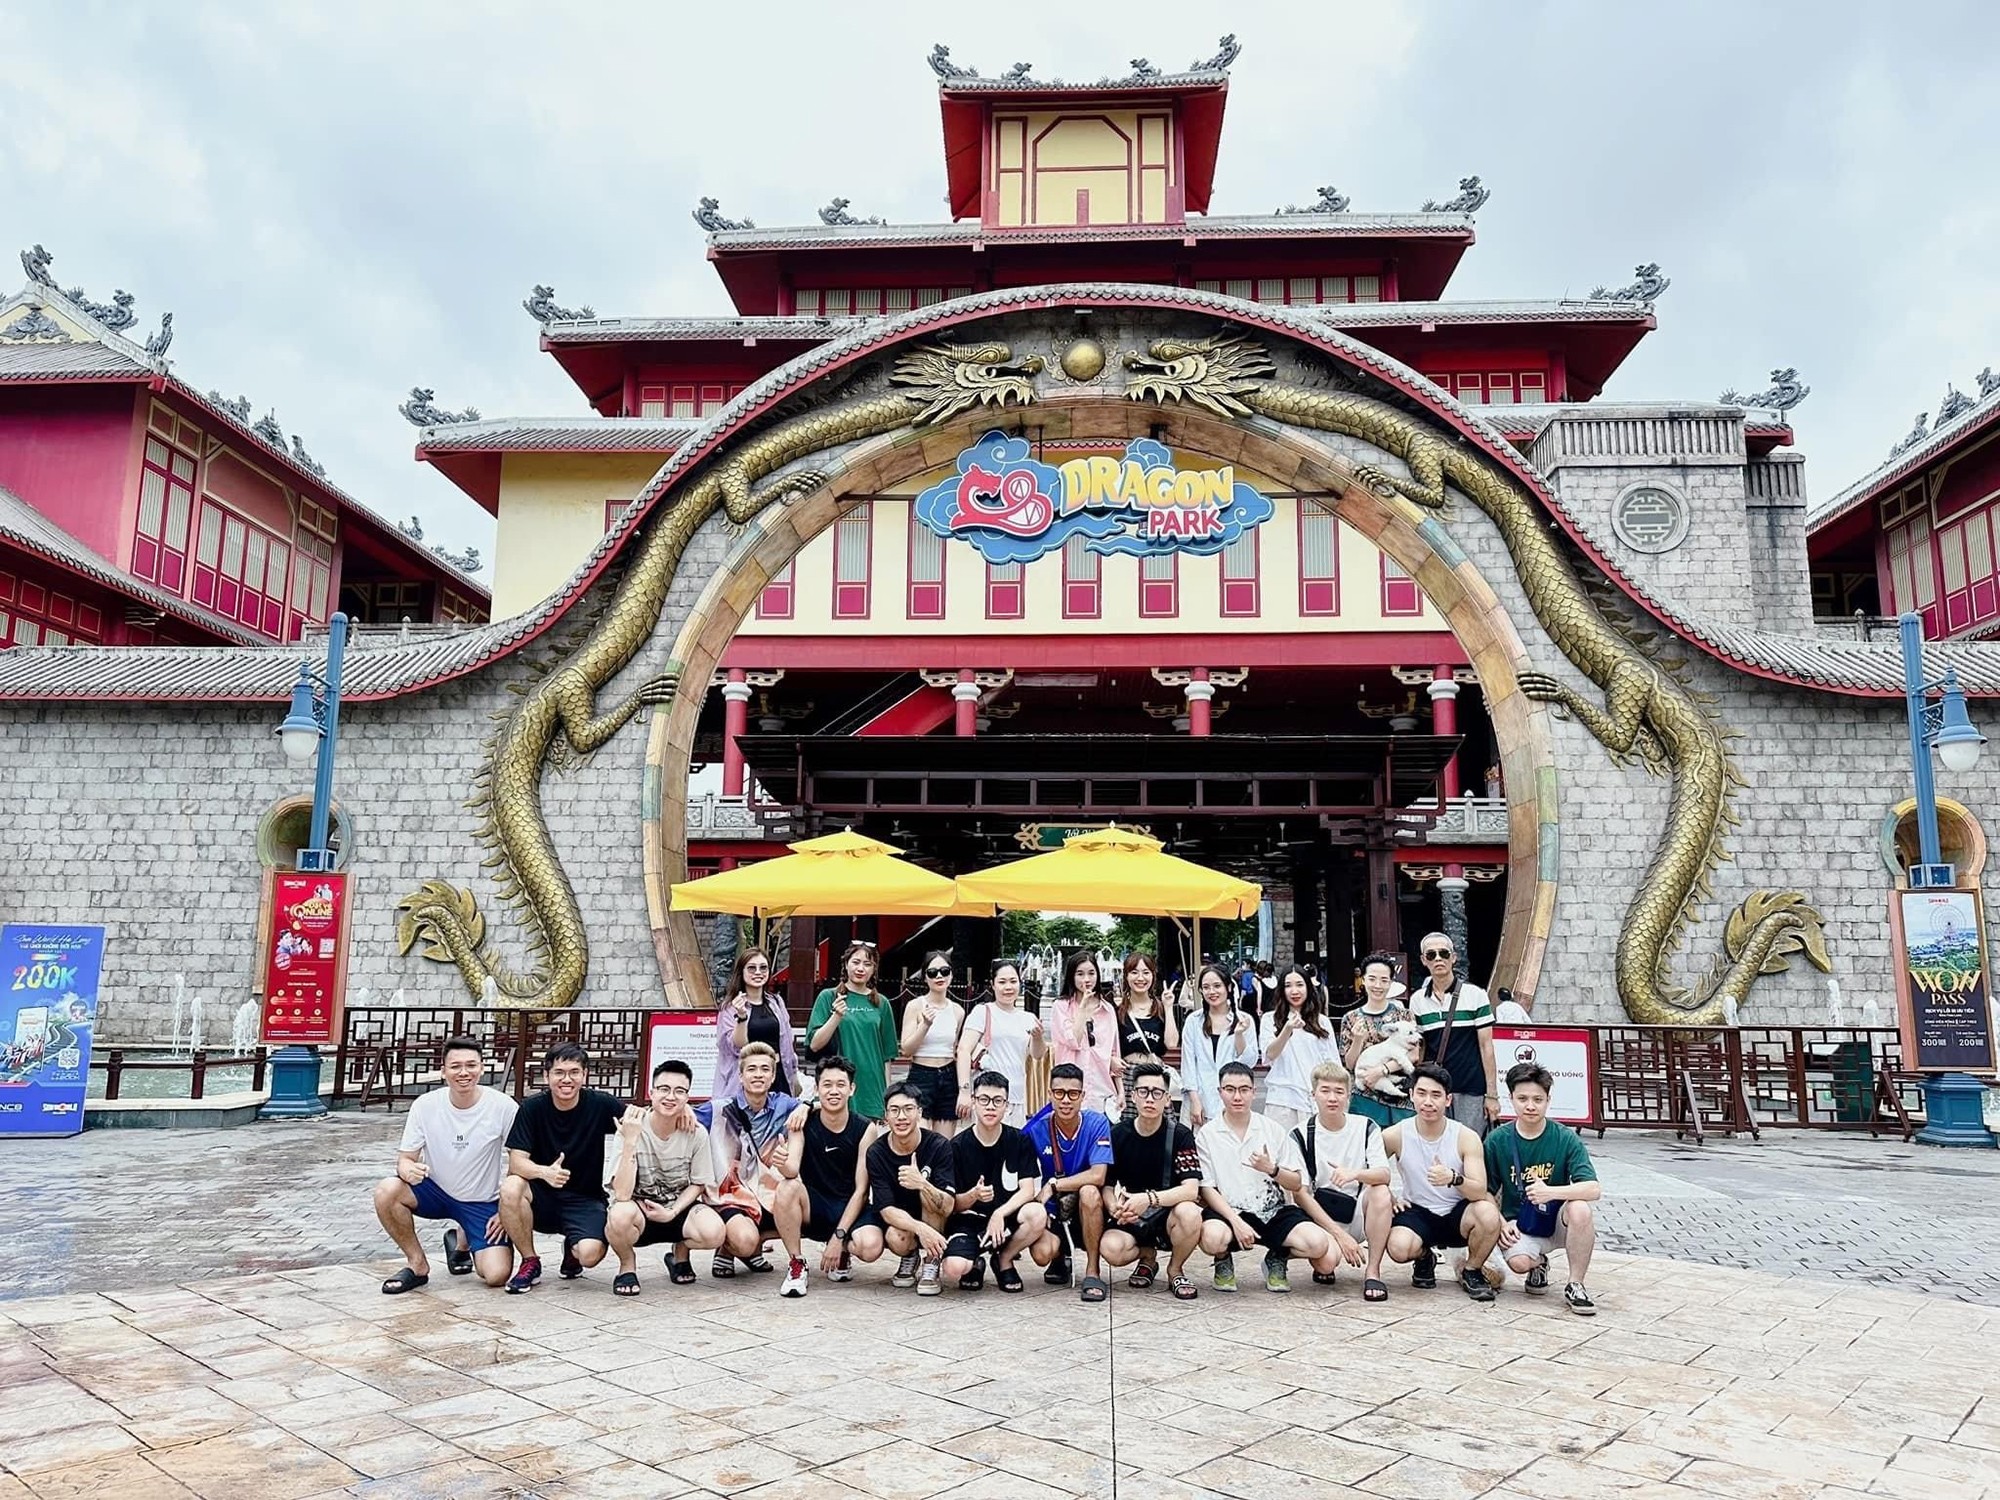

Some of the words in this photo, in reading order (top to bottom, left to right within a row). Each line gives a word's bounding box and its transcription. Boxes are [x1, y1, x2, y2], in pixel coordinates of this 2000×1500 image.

[1060, 457, 1233, 515] DRAGON
[1150, 509, 1224, 536] PARK
[12, 965, 77, 990] 200K
[1909, 971, 1981, 992] WOW
[1931, 994, 1966, 1005] PASS
